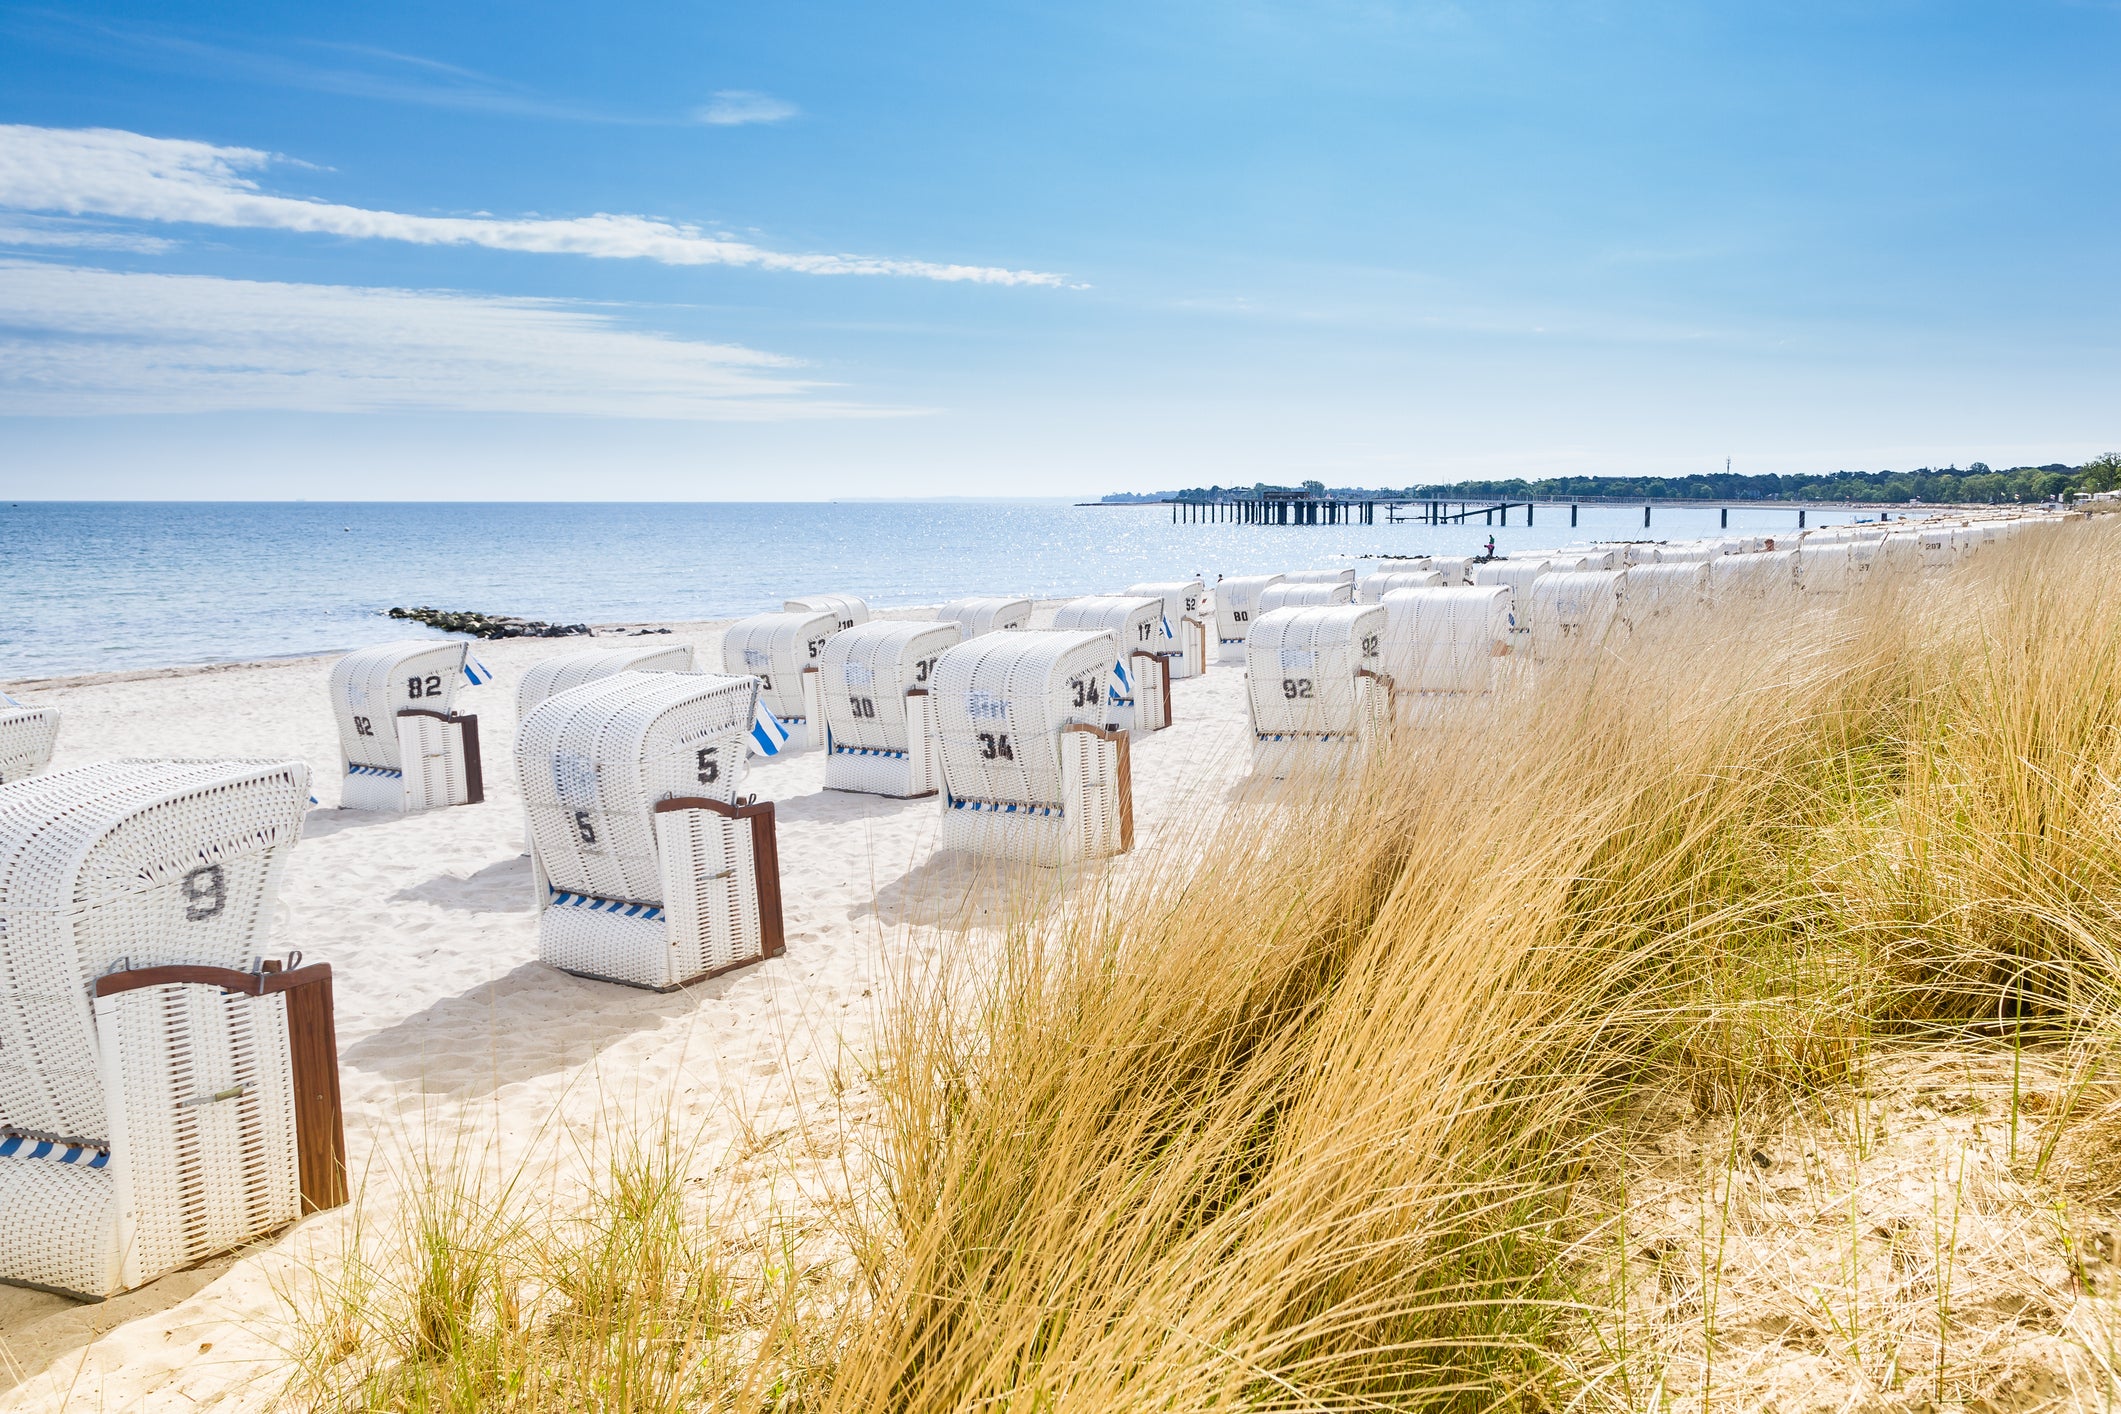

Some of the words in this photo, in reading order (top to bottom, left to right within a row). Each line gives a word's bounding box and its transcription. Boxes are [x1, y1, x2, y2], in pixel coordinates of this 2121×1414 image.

[1185, 598, 1196, 612] 52
[1233, 611, 1249, 622] 80
[1138, 624, 1151, 641] 17
[1361, 635, 1380, 657] 92
[407, 675, 443, 699] 82
[1071, 676, 1100, 708] 34
[1282, 678, 1314, 699] 92
[850, 697, 875, 718] 30
[353, 716, 375, 736] 82
[979, 733, 1014, 761] 34
[696, 746, 720, 785] 5
[574, 811, 597, 844] 5
[180, 863, 227, 922] 9
